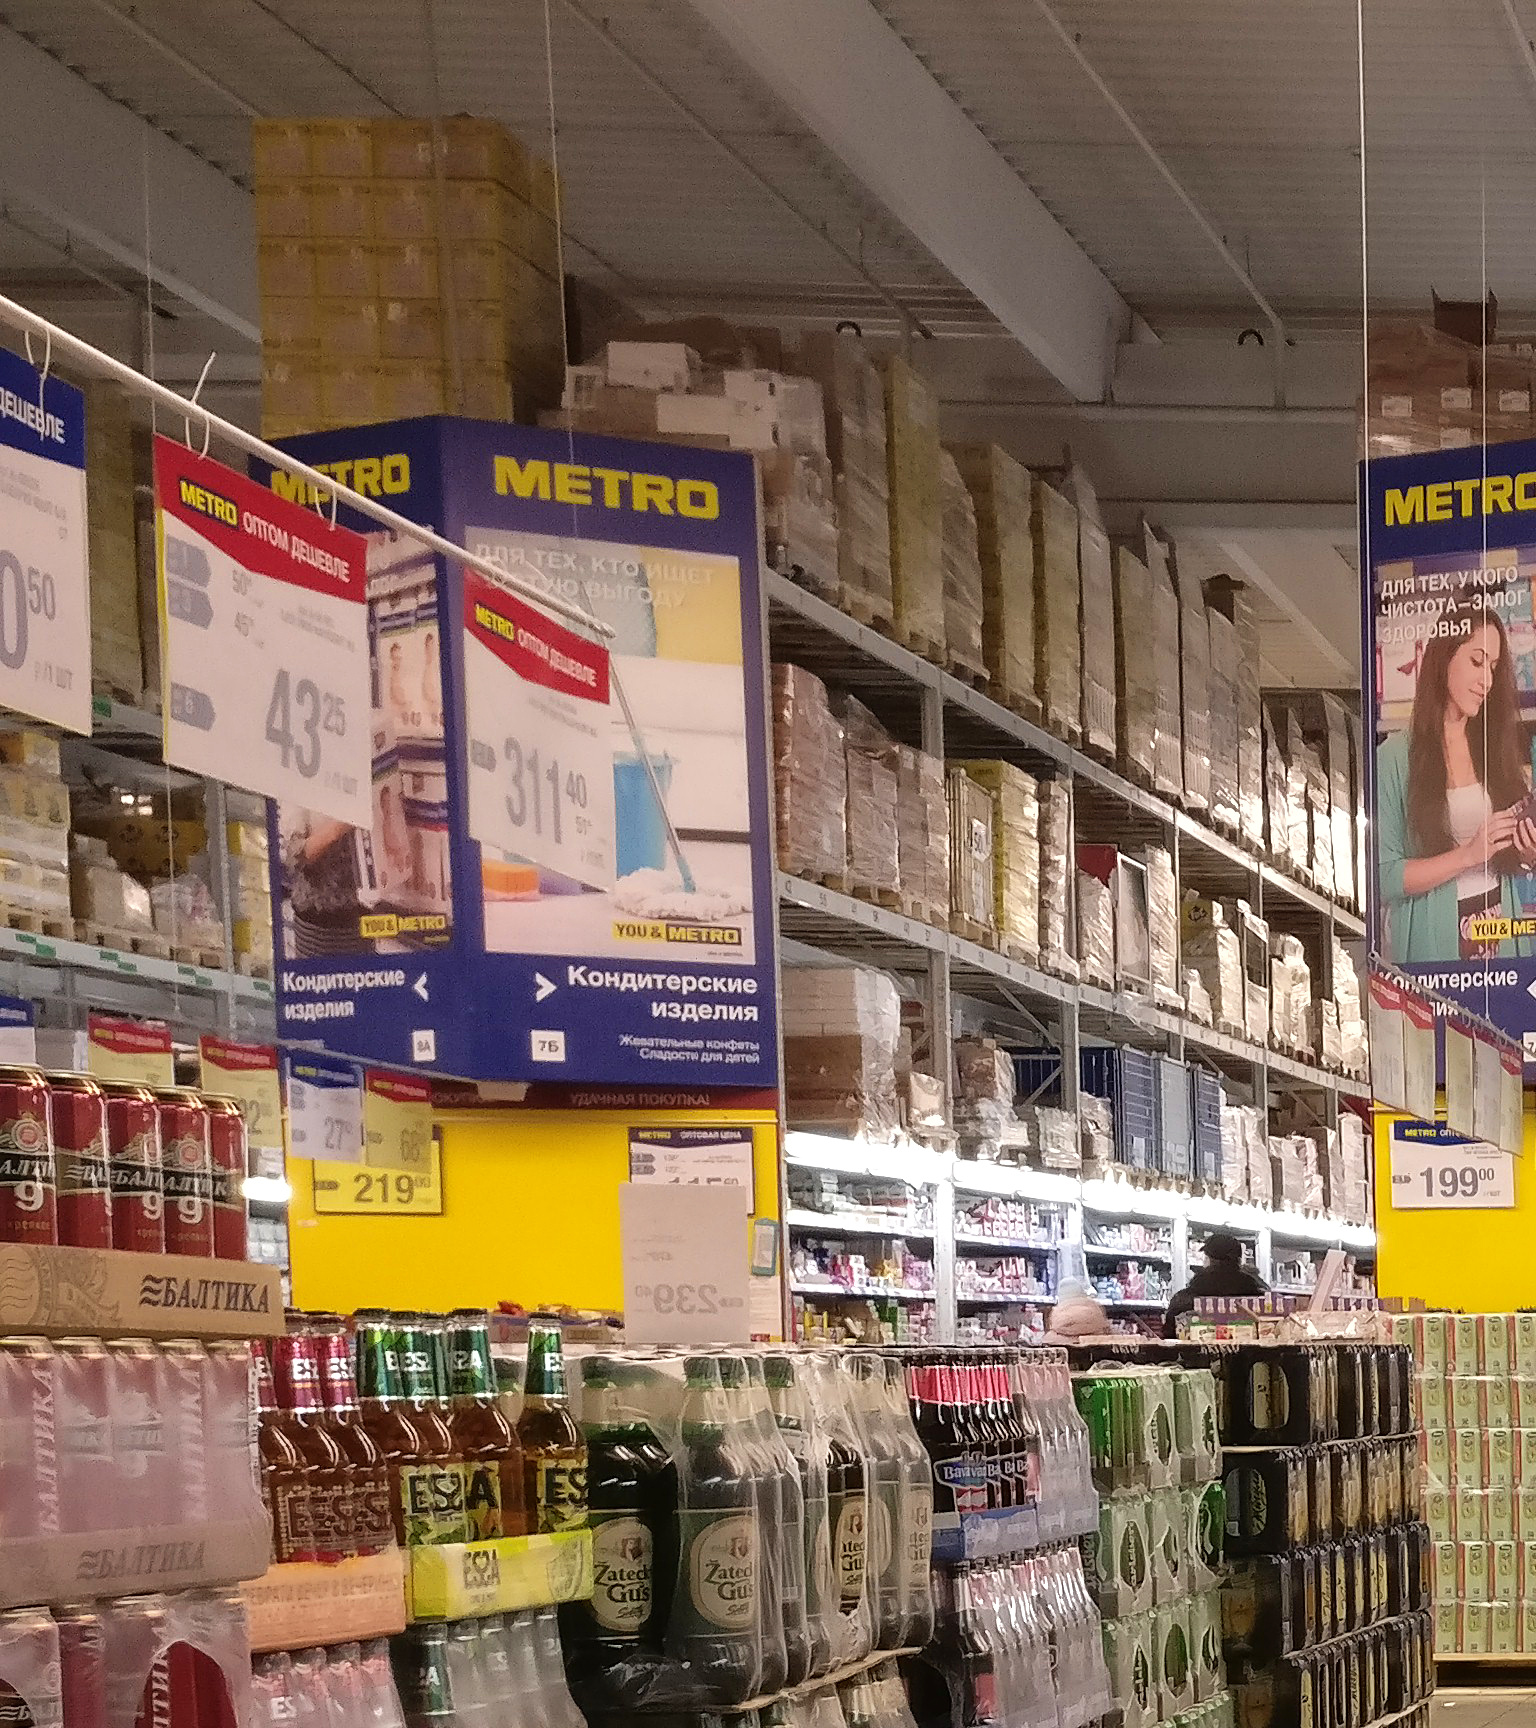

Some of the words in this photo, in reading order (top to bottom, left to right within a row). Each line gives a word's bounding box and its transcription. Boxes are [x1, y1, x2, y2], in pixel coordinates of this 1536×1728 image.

[493, 454, 720, 520] METRO
[180, 479, 239, 526] METRO
[242, 511, 289, 551] ОПТОМ
[291, 537, 350, 583] ДЕШЕВЛЕ
[590, 555, 642, 577] КТО
[1380, 577, 1415, 600] ДЛЯ
[1418, 571, 1456, 593] ТЕХ,
[1473, 565, 1519, 586] КОГО
[474, 602, 515, 642] METRO
[1381, 617, 1472, 645] ЗДОРОВЬЯ
[265, 668, 322, 778] 43
[503, 736, 562, 845] 311
[615, 921, 647, 940] YOU
[668, 926, 740, 944] METRO
[1473, 920, 1496, 938] YOU
[282, 968, 405, 992] Кондитерские
[567, 964, 758, 994] Кондитерские
[284, 998, 355, 1021] изделия
[650, 1001, 759, 1023] изделия
[353, 1172, 415, 1204] 219
[1419, 1166, 1479, 1198] 199
[1478, 1167, 1495, 1181] 00
[161, 1276, 269, 1313] БАЛТИКА
